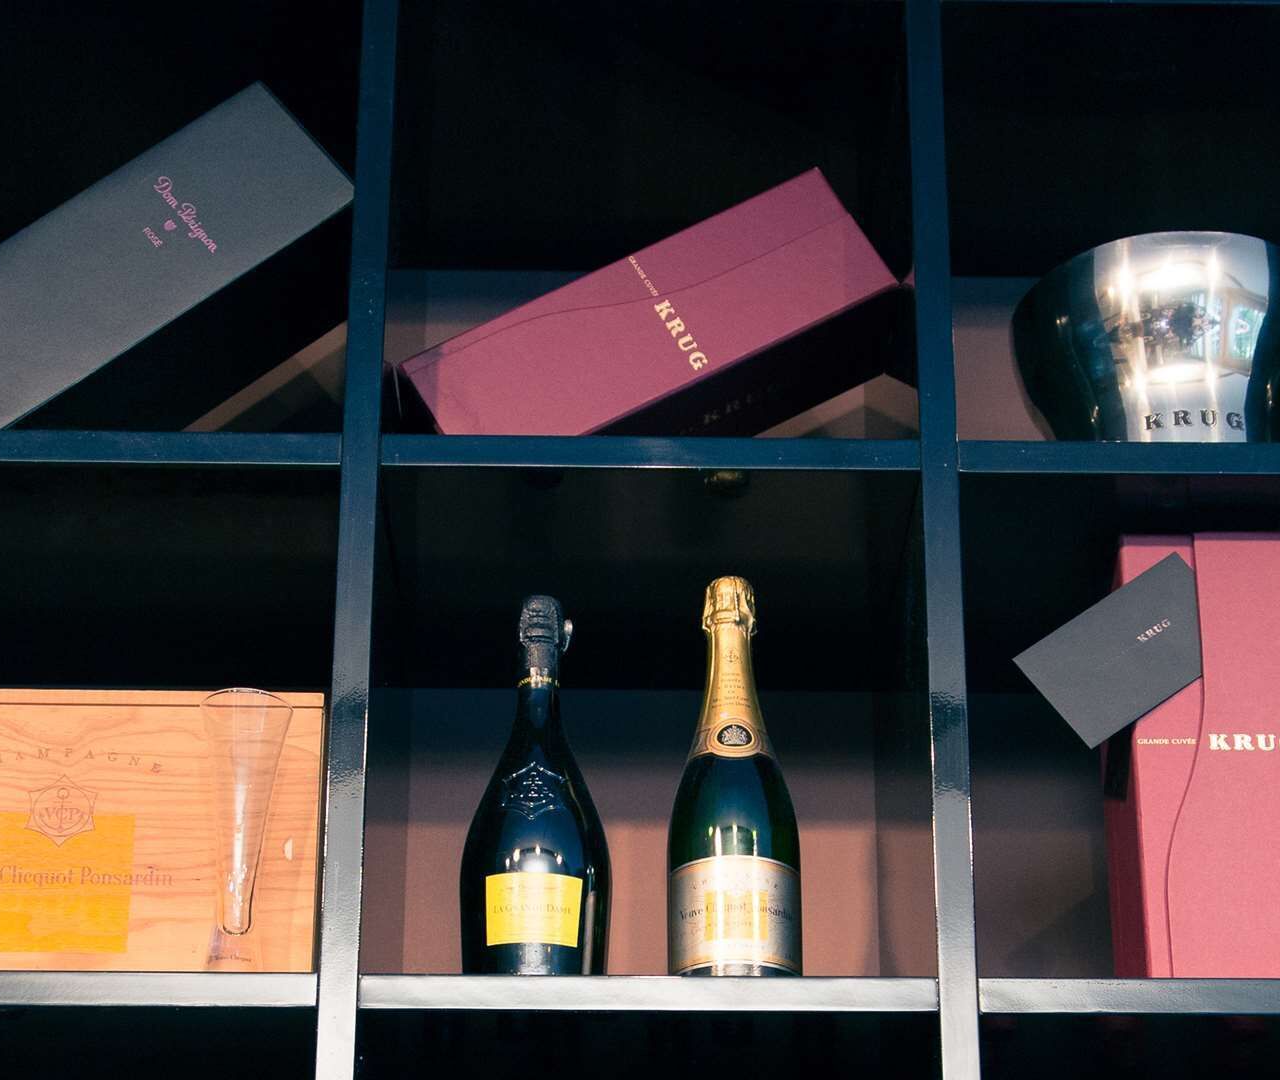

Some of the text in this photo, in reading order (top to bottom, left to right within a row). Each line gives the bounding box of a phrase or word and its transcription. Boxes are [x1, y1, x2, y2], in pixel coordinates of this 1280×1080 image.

[152, 176, 219, 255] Dom Pérignon
[653, 299, 709, 371] KRUG
[1143, 408, 1245, 431] KRUG
[1136, 618, 1172, 644] KRUG
[0, 865, 74, 889] Clicquot
[79, 865, 174, 887] Ponsardin
